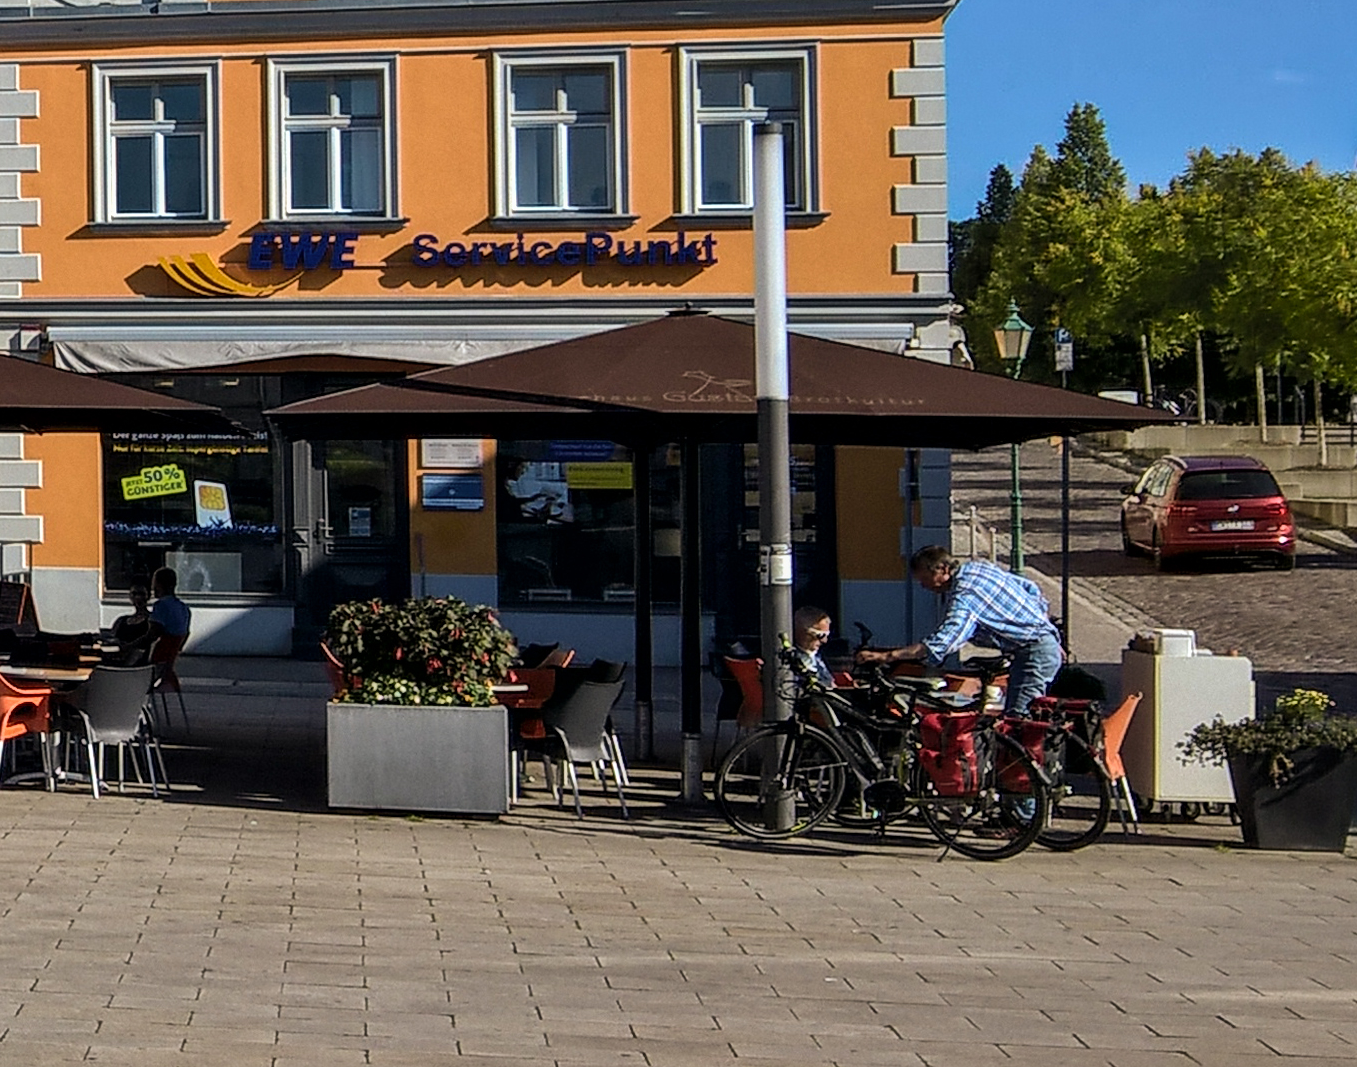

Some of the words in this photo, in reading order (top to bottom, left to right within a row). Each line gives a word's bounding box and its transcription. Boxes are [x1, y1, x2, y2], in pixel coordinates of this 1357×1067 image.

[247, 233, 360, 270] EWE
[412, 231, 718, 268] ServicePunkt
[662, 391, 754, 402] Gusta
